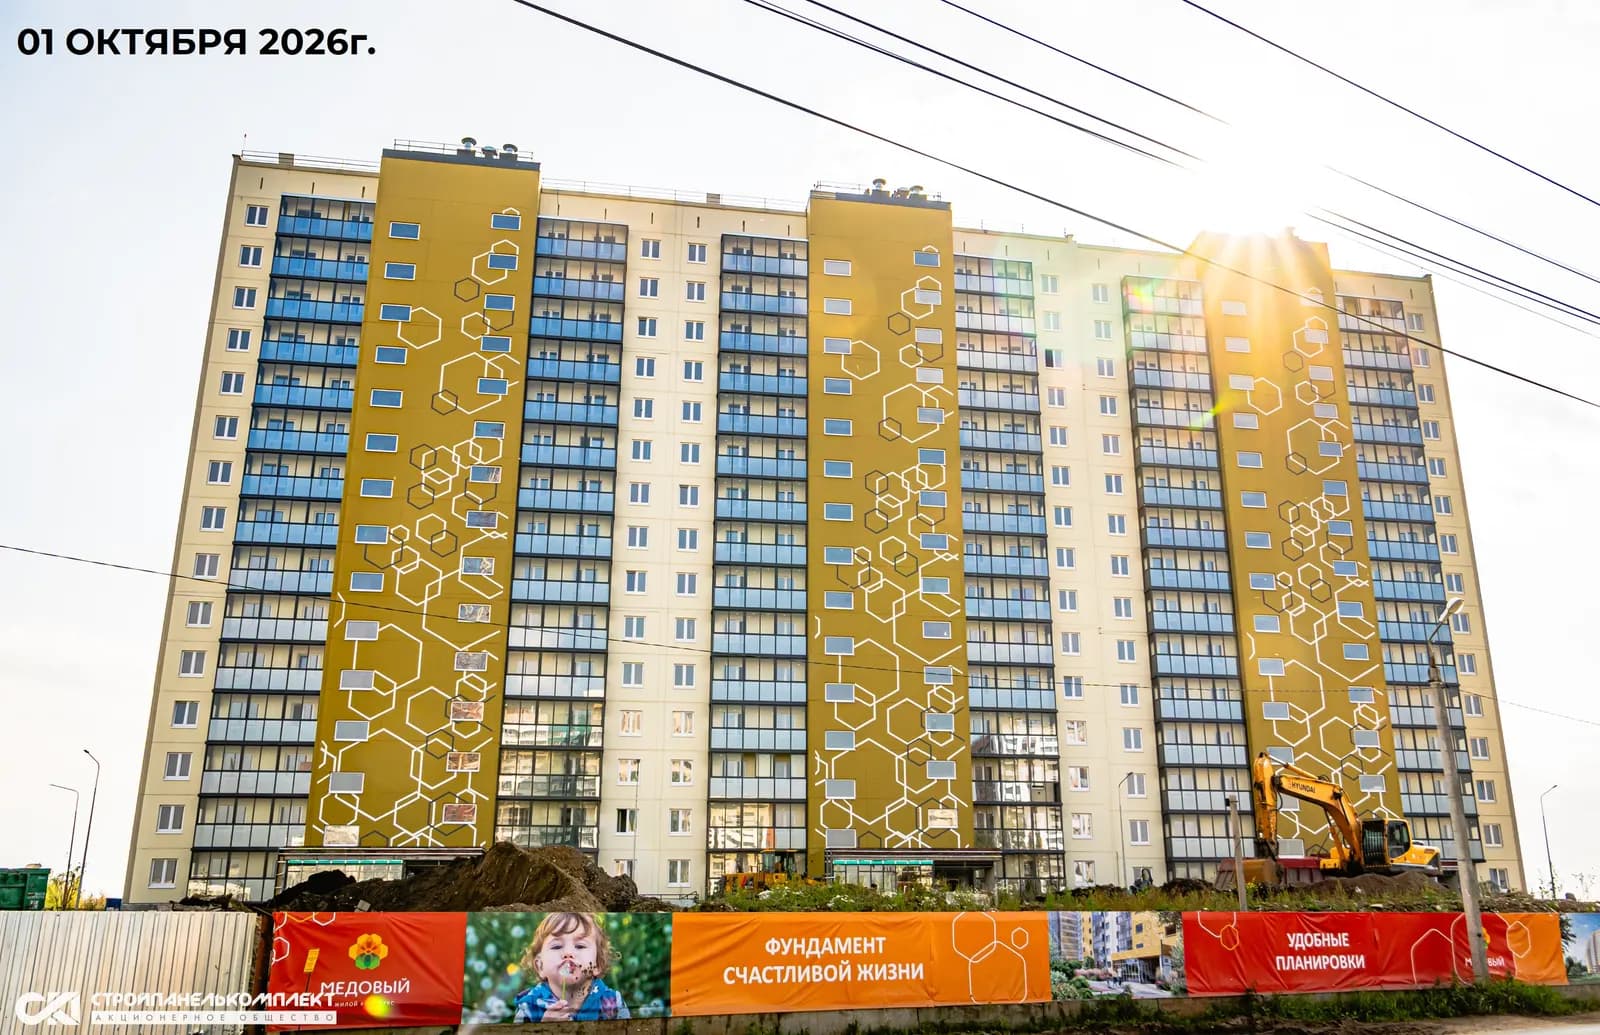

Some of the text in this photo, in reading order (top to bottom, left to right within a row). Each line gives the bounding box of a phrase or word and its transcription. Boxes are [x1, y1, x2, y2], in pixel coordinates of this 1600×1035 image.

[1291, 781, 1316, 793] HYUNDAI
[764, 936, 887, 958] ФУНДАМЕНТ
[1286, 931, 1350, 949] УДОБНЫЕ
[1275, 953, 1366, 971] ПЛАНИРОВКИ
[1464, 956, 1505, 967] МВЫЙ
[723, 960, 925, 985] СЧАСТЛИВОЙ ЖИЗНИ
[320, 977, 411, 998] МЕДОВЫЙ
